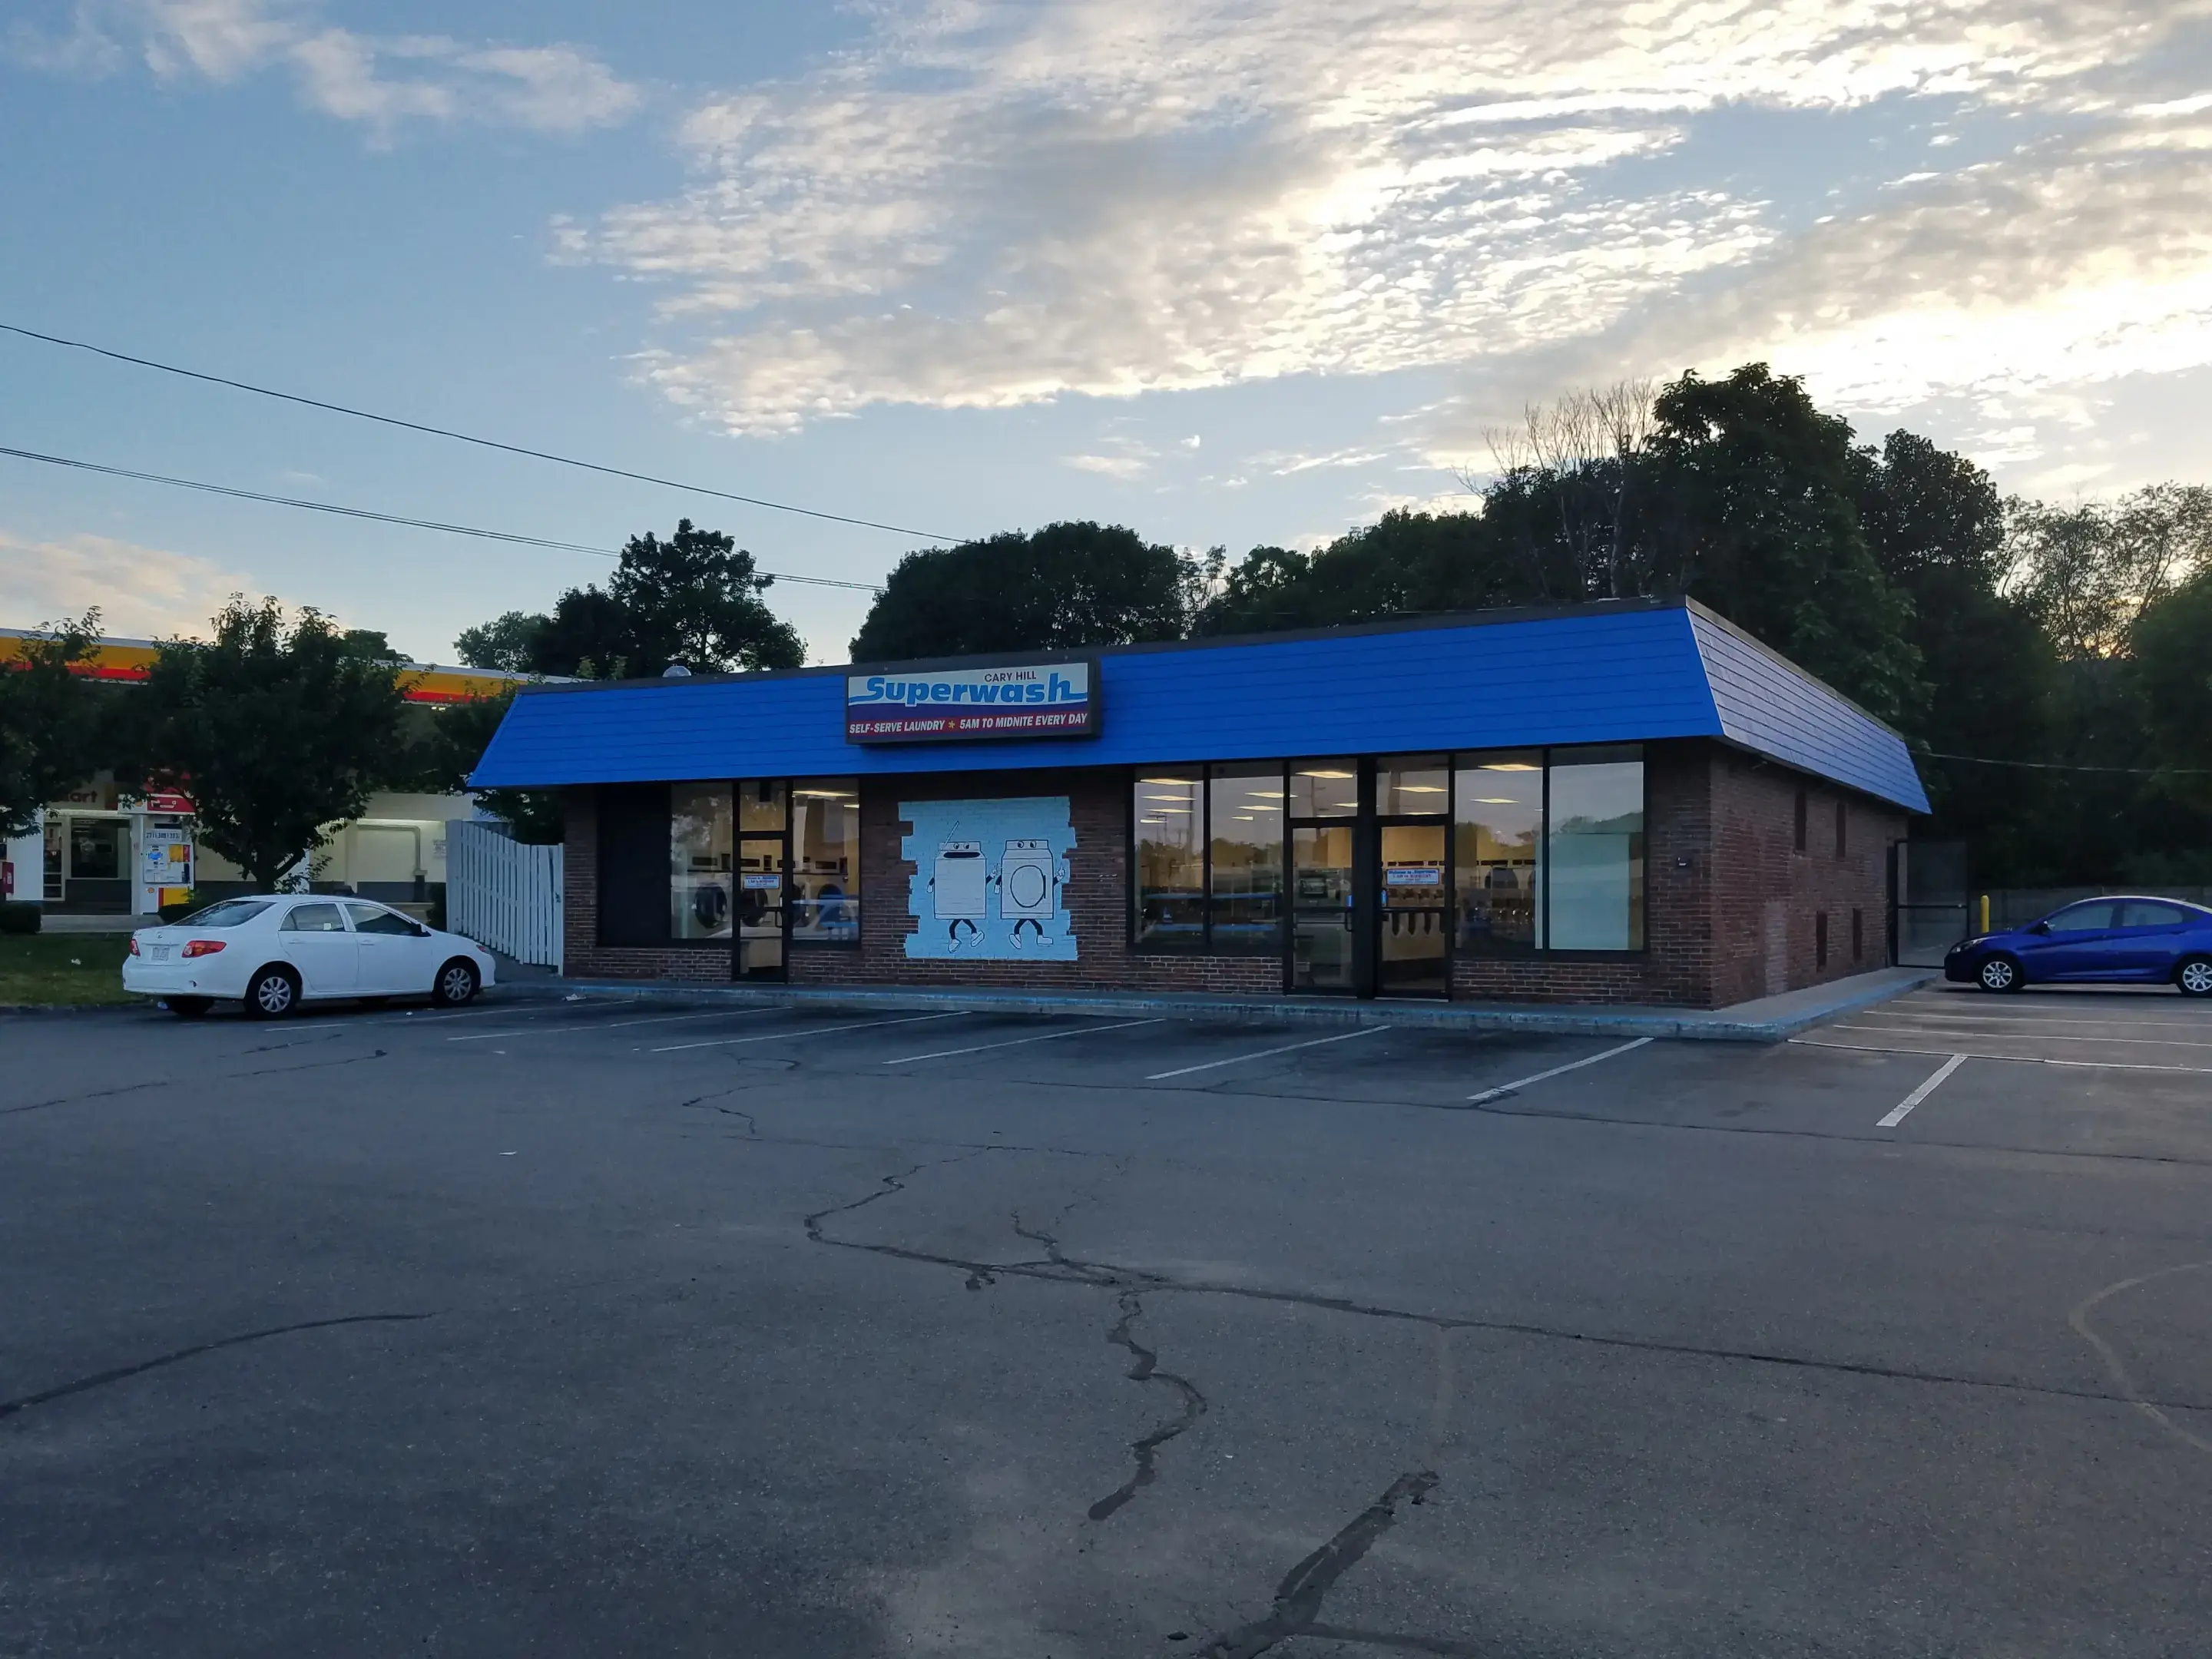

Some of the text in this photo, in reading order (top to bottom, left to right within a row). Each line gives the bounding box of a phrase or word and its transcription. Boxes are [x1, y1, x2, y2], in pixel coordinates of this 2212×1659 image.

[984, 671, 1037, 683] CARY HILL
[849, 672, 1088, 705] Superwash
[849, 713, 1088, 734] SELF-SERVE LAUNDRY 5AM TO MIDNITE EVERY DAY
